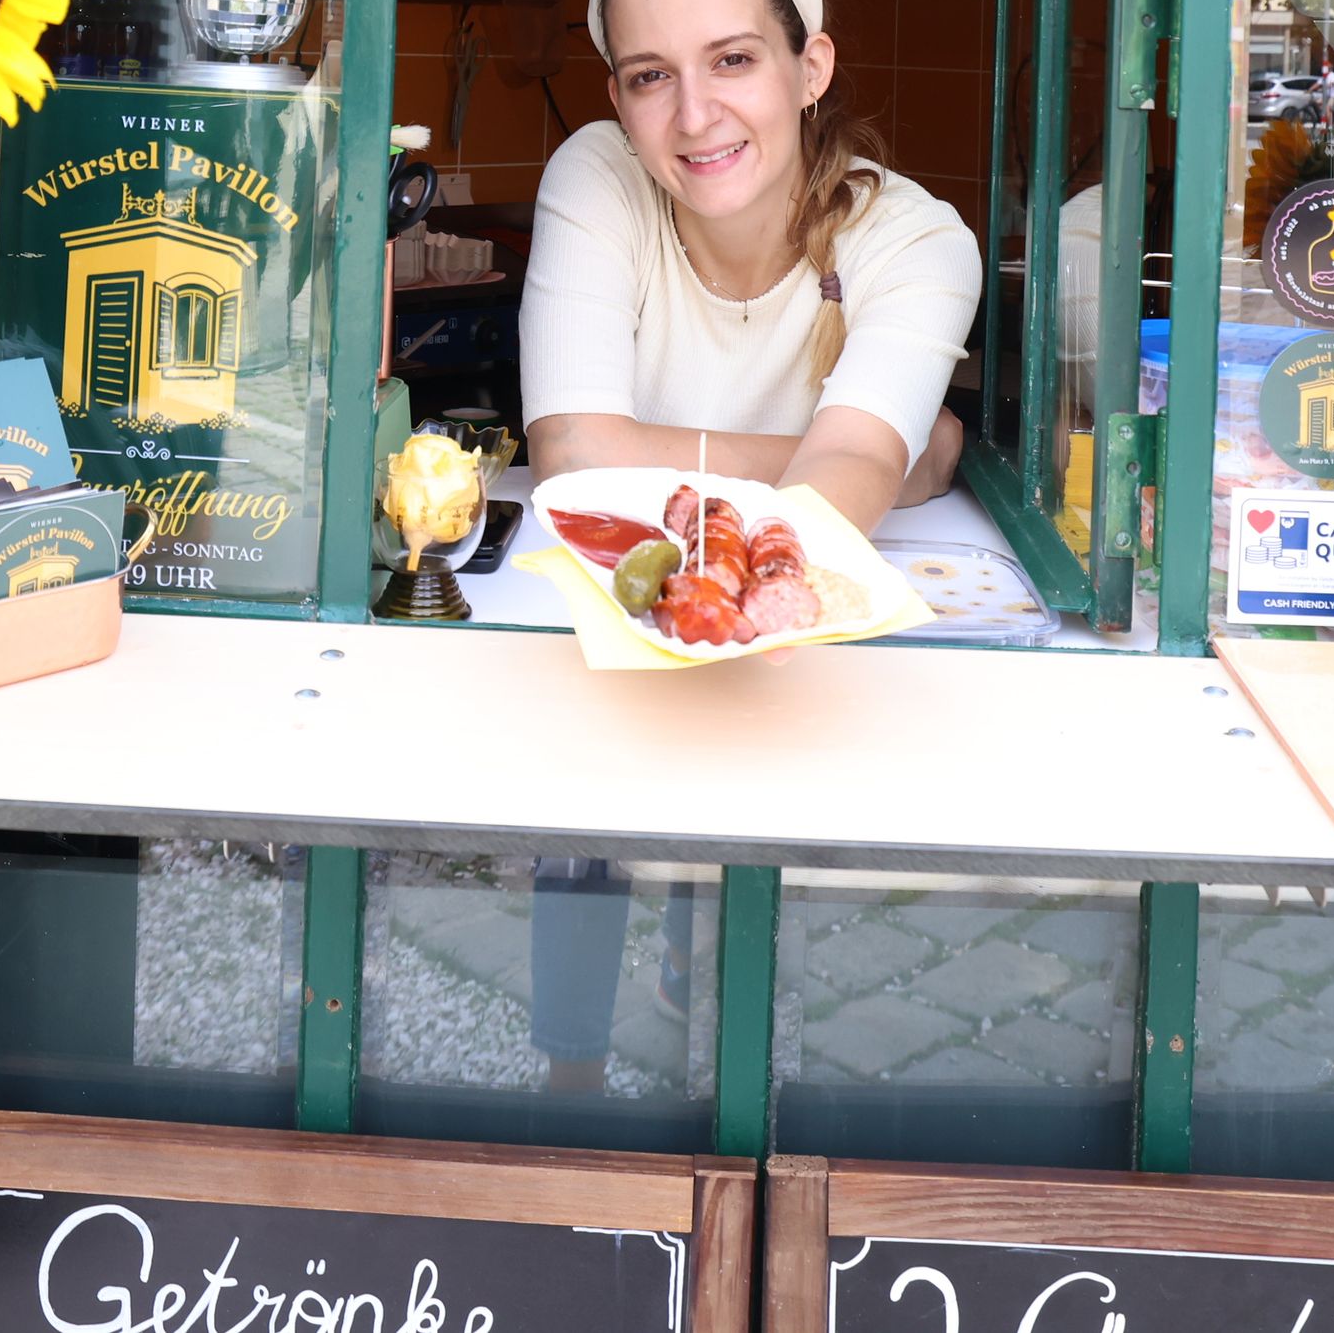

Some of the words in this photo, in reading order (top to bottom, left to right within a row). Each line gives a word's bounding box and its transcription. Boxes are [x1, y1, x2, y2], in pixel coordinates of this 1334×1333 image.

[122, 116, 206, 133] WIENER
[22, 141, 159, 208] Würstel
[168, 144, 300, 233] Pavillon
[1283, 218, 1298, 237] 2022
[1285, 272, 1324, 308] Würstelstand
[1283, 352, 1332, 378] Würstel
[30, 517, 63, 528] WIENER
[47, 527, 95, 551] Pavillon
[173, 542, 263, 562] SONNTAG
[155, 565, 217, 590] UHR
[1263, 598, 1290, 608] CASH
[38, 1204, 494, 1333] Getränke
